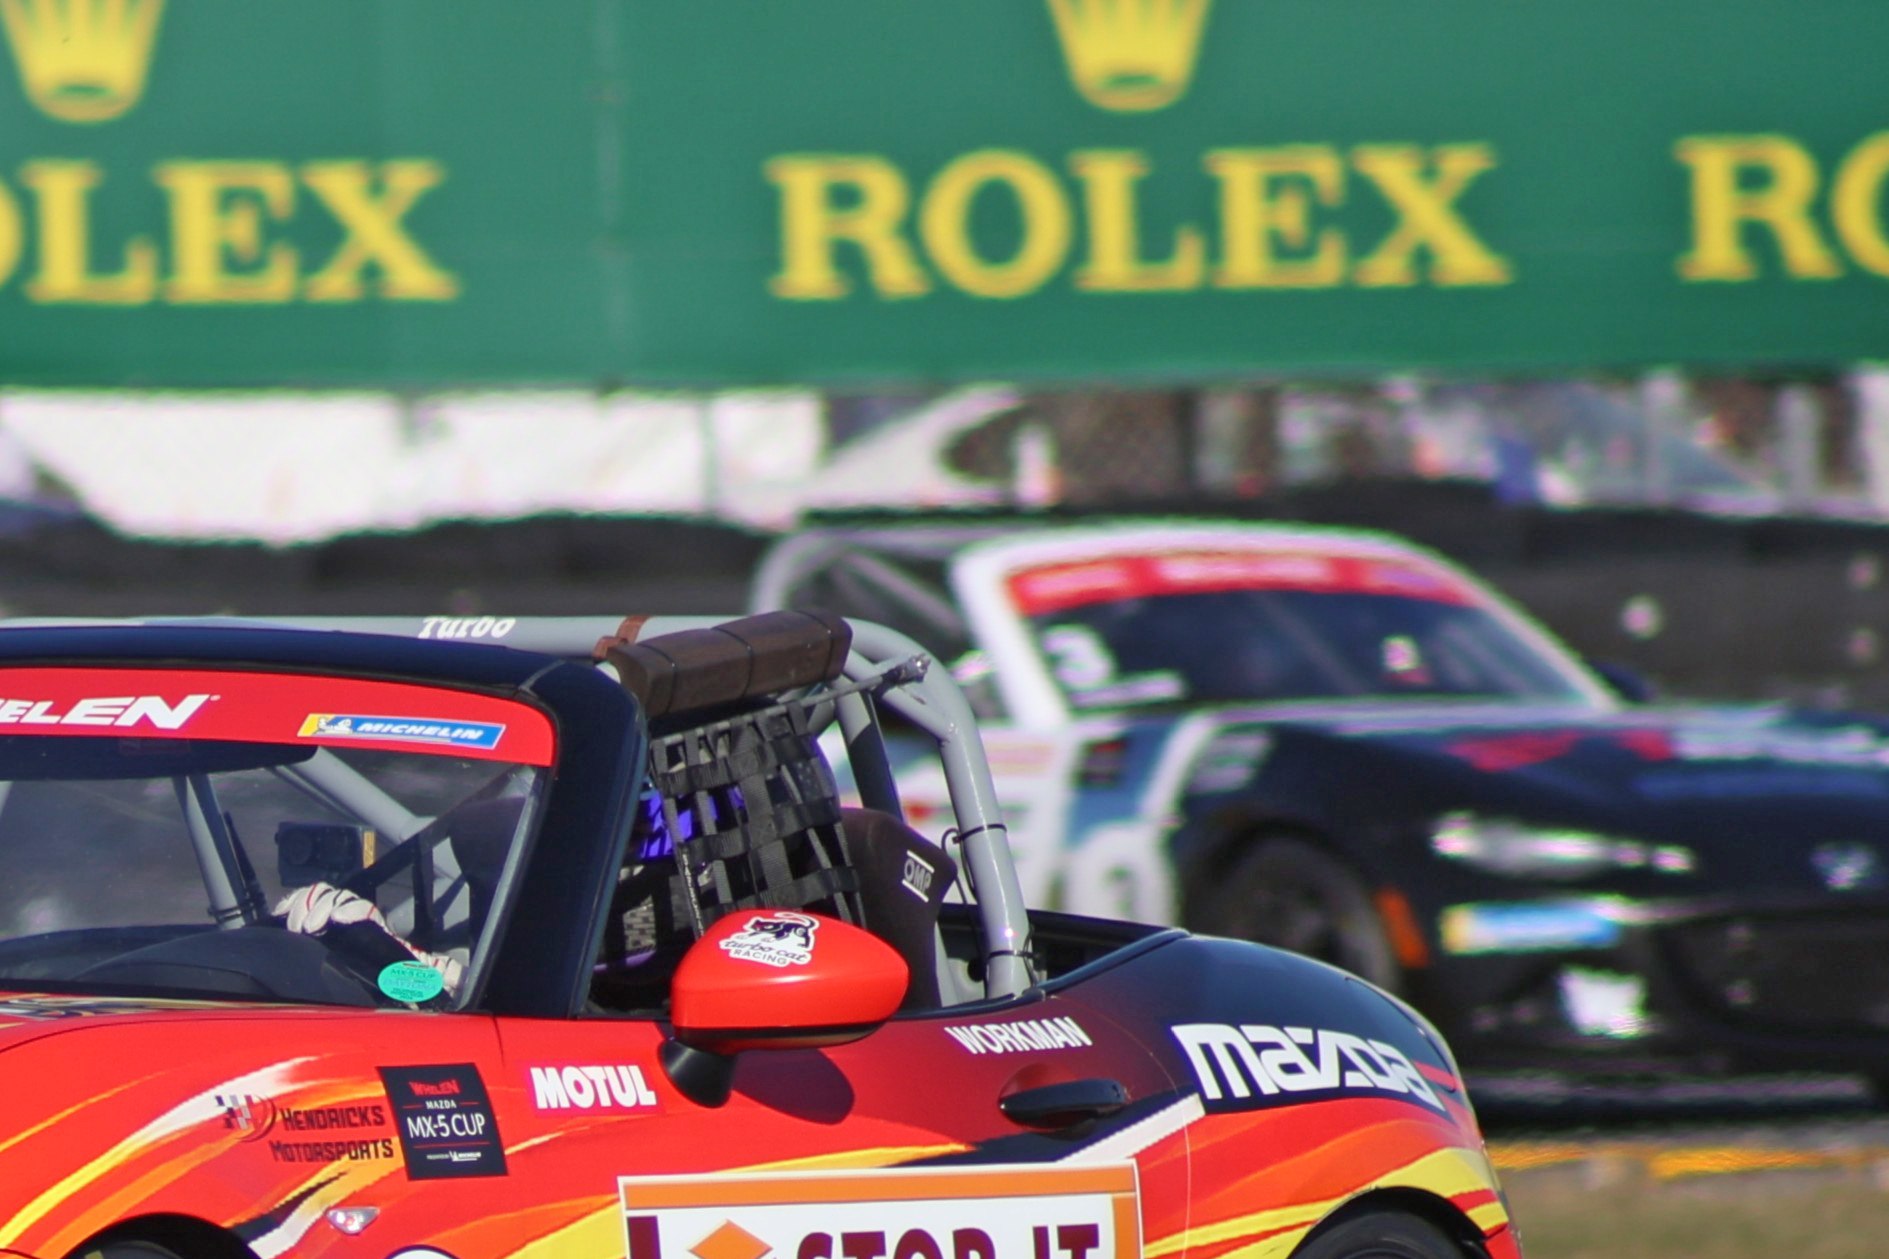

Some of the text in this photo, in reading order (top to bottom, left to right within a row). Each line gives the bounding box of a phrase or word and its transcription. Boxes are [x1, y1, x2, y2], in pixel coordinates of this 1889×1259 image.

[764, 143, 1514, 300] ROLEX
[417, 616, 516, 640] Turbo
[356, 721, 484, 741] MICHELIN
[904, 858, 933, 894] OMP
[724, 940, 807, 962] turbo cat
[733, 949, 788, 965] RACING
[944, 1016, 1092, 1055] WORKMAN
[1172, 1023, 1445, 1113] mazda
[408, 1079, 460, 1096] WHELEN
[531, 1065, 656, 1109] MOTUL
[425, 1100, 457, 1109] MAZDA
[280, 1105, 386, 1131] HENDRICKS
[407, 1113, 486, 1139] MX-5 CUP
[269, 1139, 395, 1163] MOTORSPORTS
